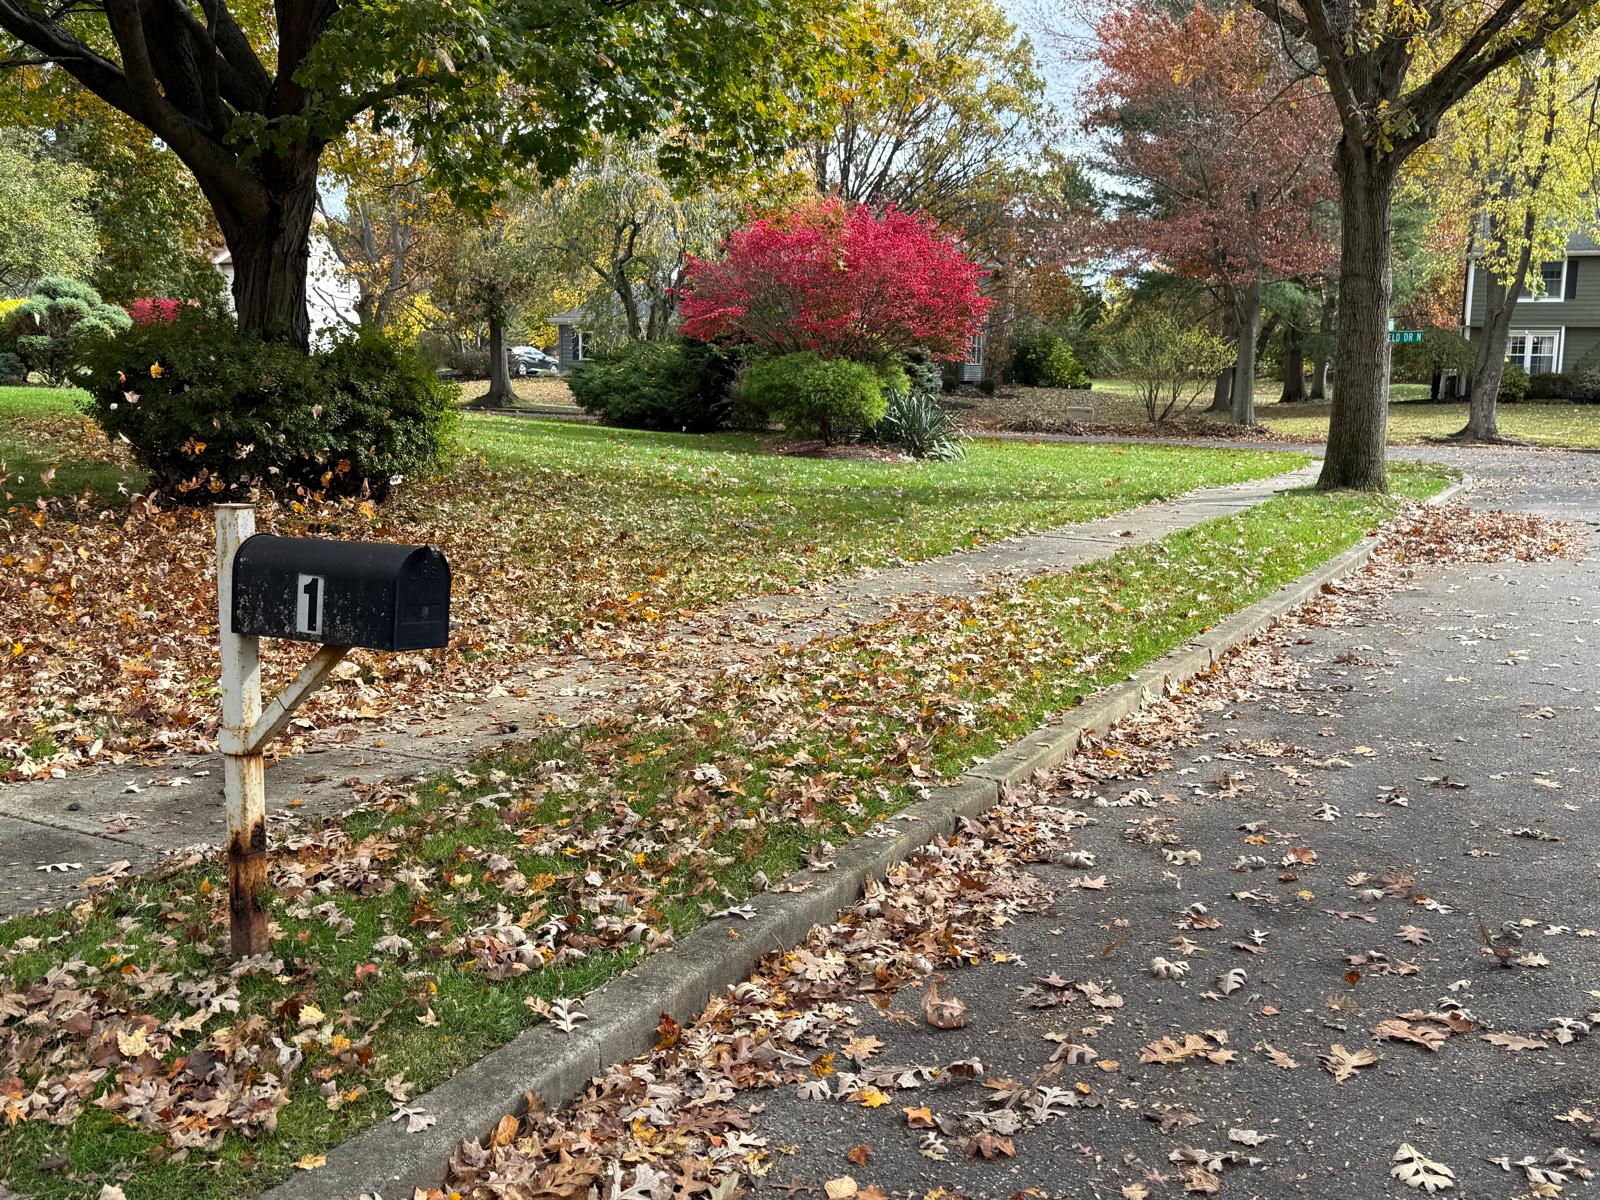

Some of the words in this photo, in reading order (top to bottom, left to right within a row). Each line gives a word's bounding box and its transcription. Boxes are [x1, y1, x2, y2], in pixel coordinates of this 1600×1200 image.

[1403, 332, 1413, 342] DR
[1416, 332, 1422, 342] N
[303, 577, 319, 632] 1
